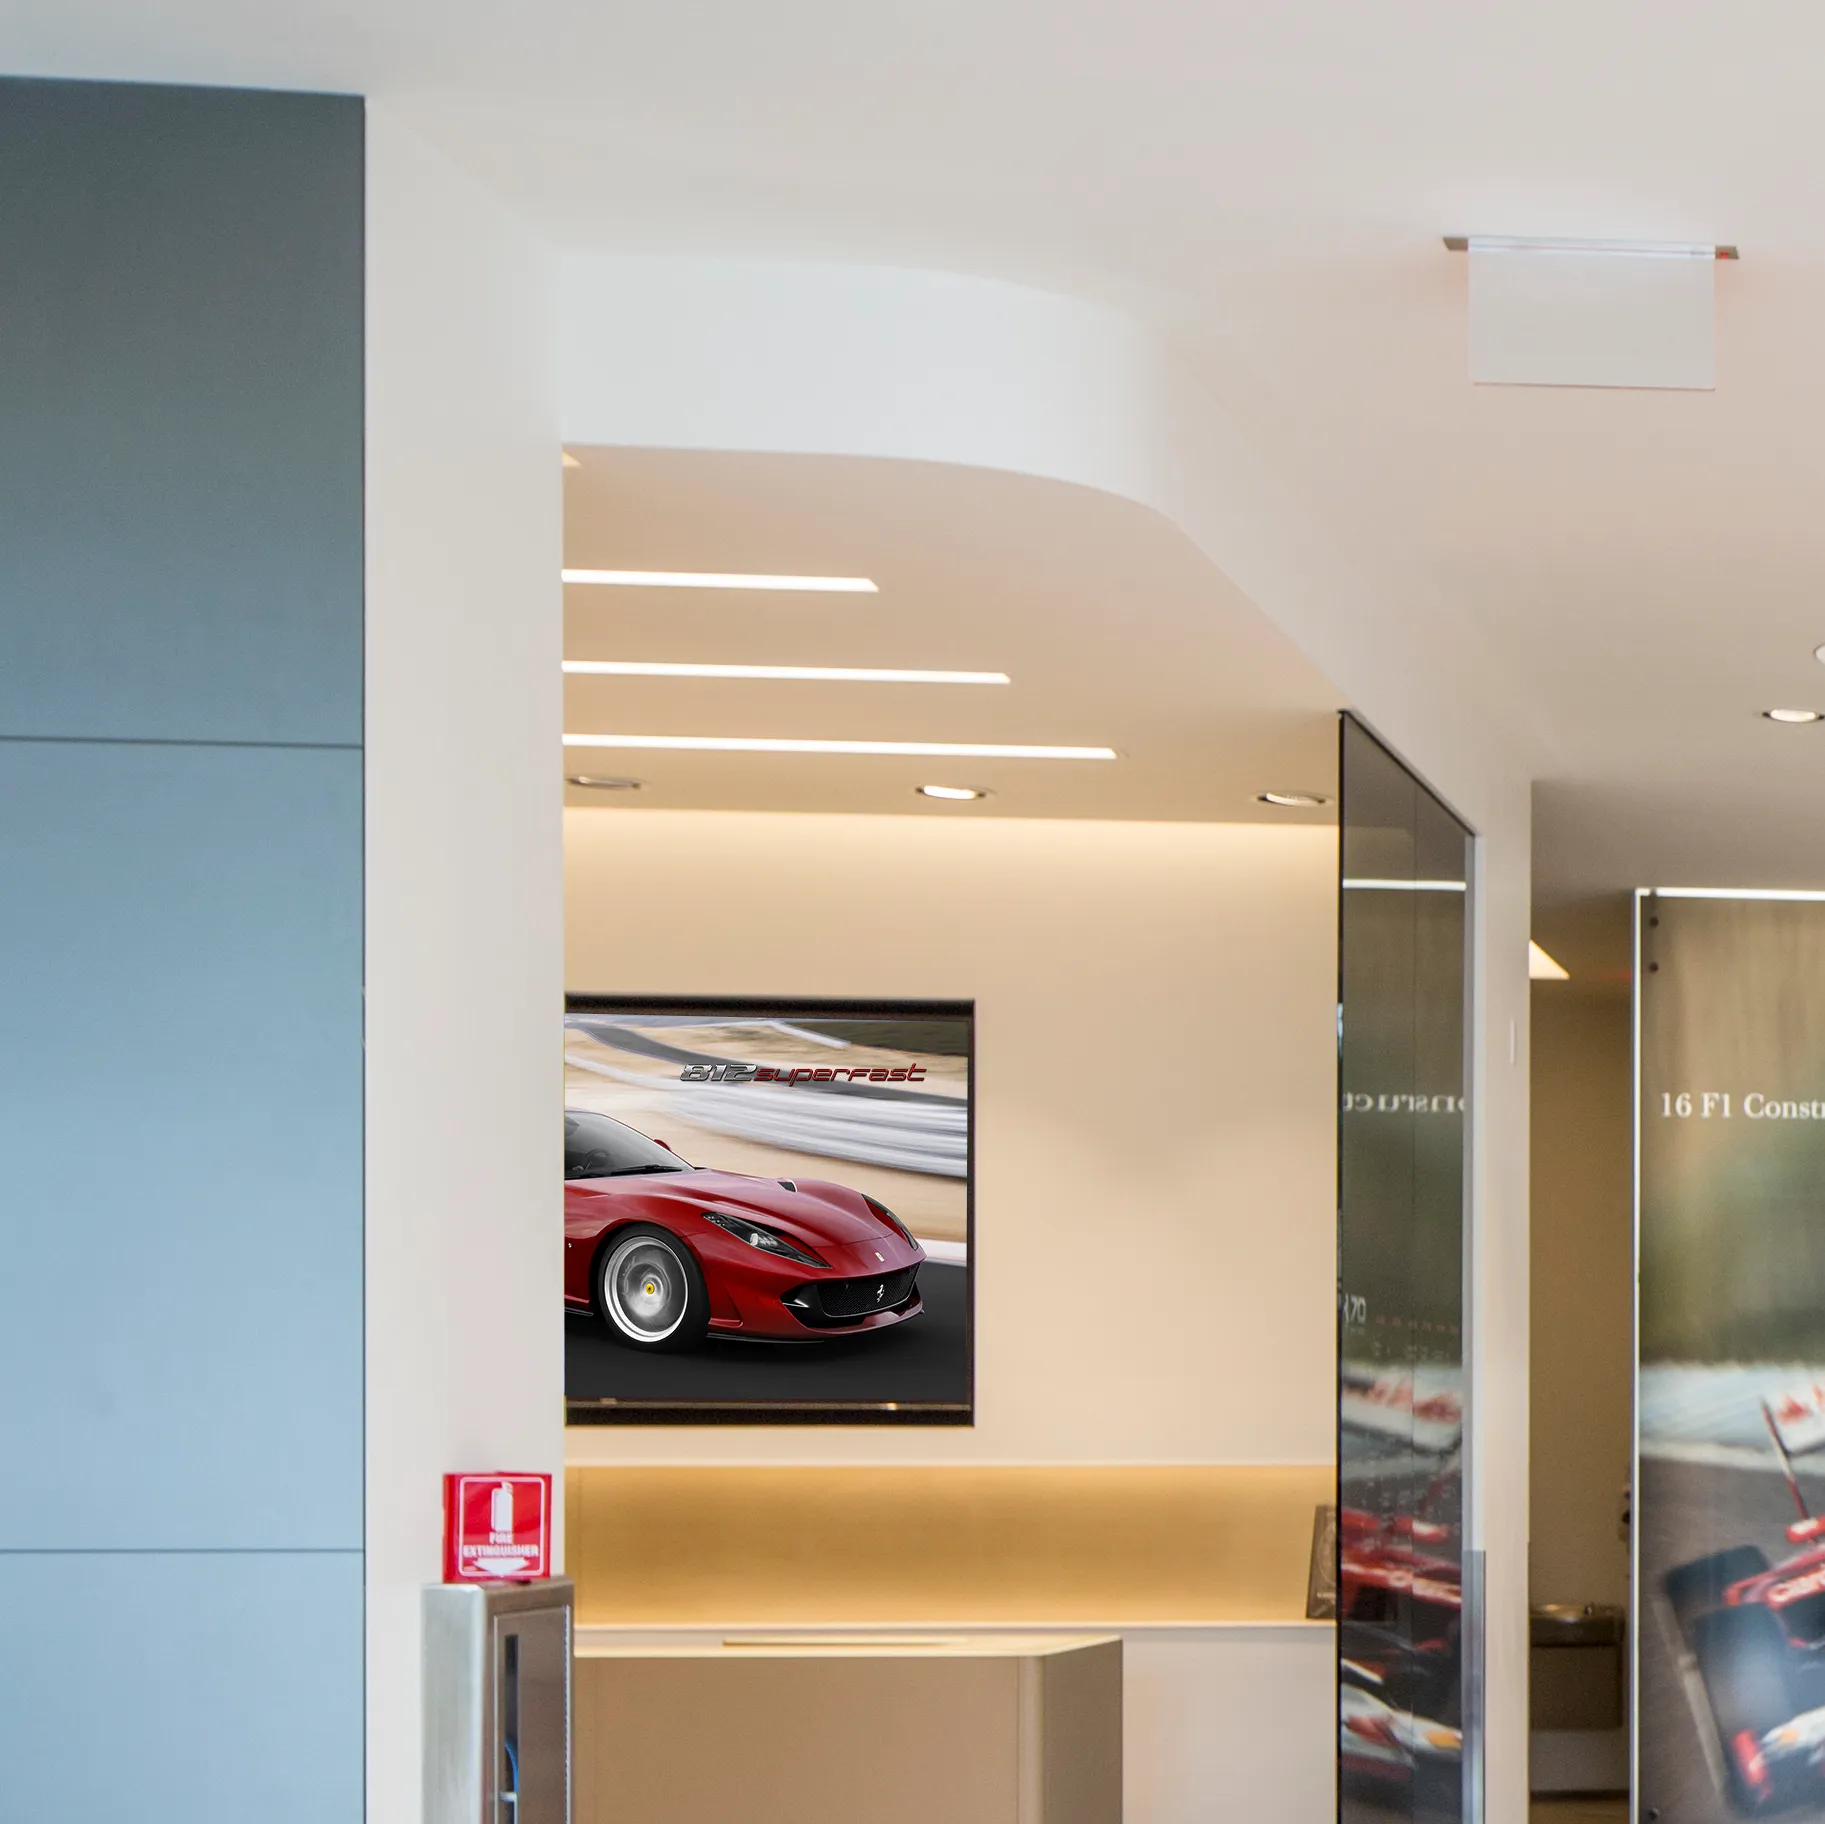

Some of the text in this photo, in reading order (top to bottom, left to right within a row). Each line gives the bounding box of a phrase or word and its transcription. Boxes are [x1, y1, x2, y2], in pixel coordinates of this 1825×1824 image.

[1662, 1092, 1692, 1117] 16
[1701, 1092, 1730, 1118] F1
[489, 1531, 514, 1545] FIRE
[463, 1544, 539, 1558] EXTINGUISHER
